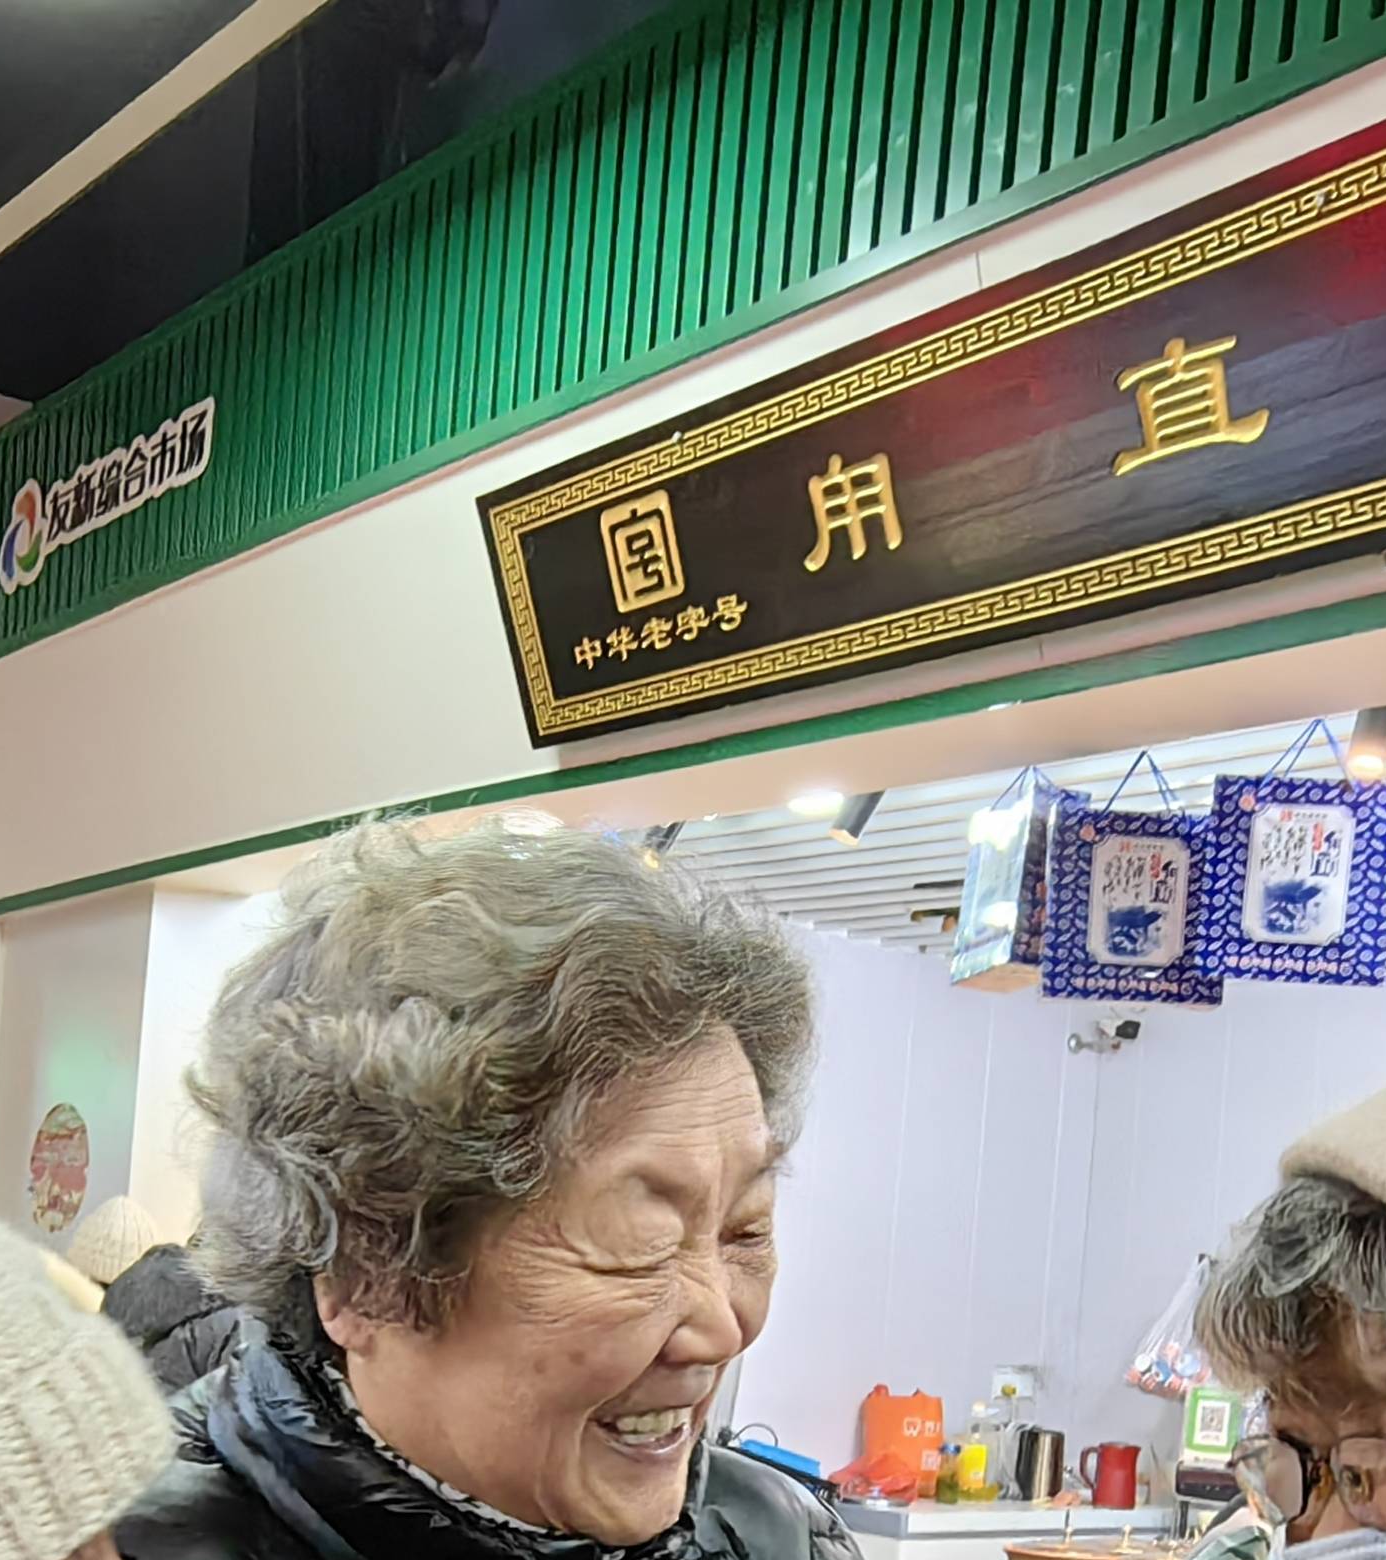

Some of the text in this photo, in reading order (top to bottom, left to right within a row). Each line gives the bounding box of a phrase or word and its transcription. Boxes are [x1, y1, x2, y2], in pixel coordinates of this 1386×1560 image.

[45, 411, 207, 540] 友新综合市场
[573, 593, 749, 671] 中华老字号
